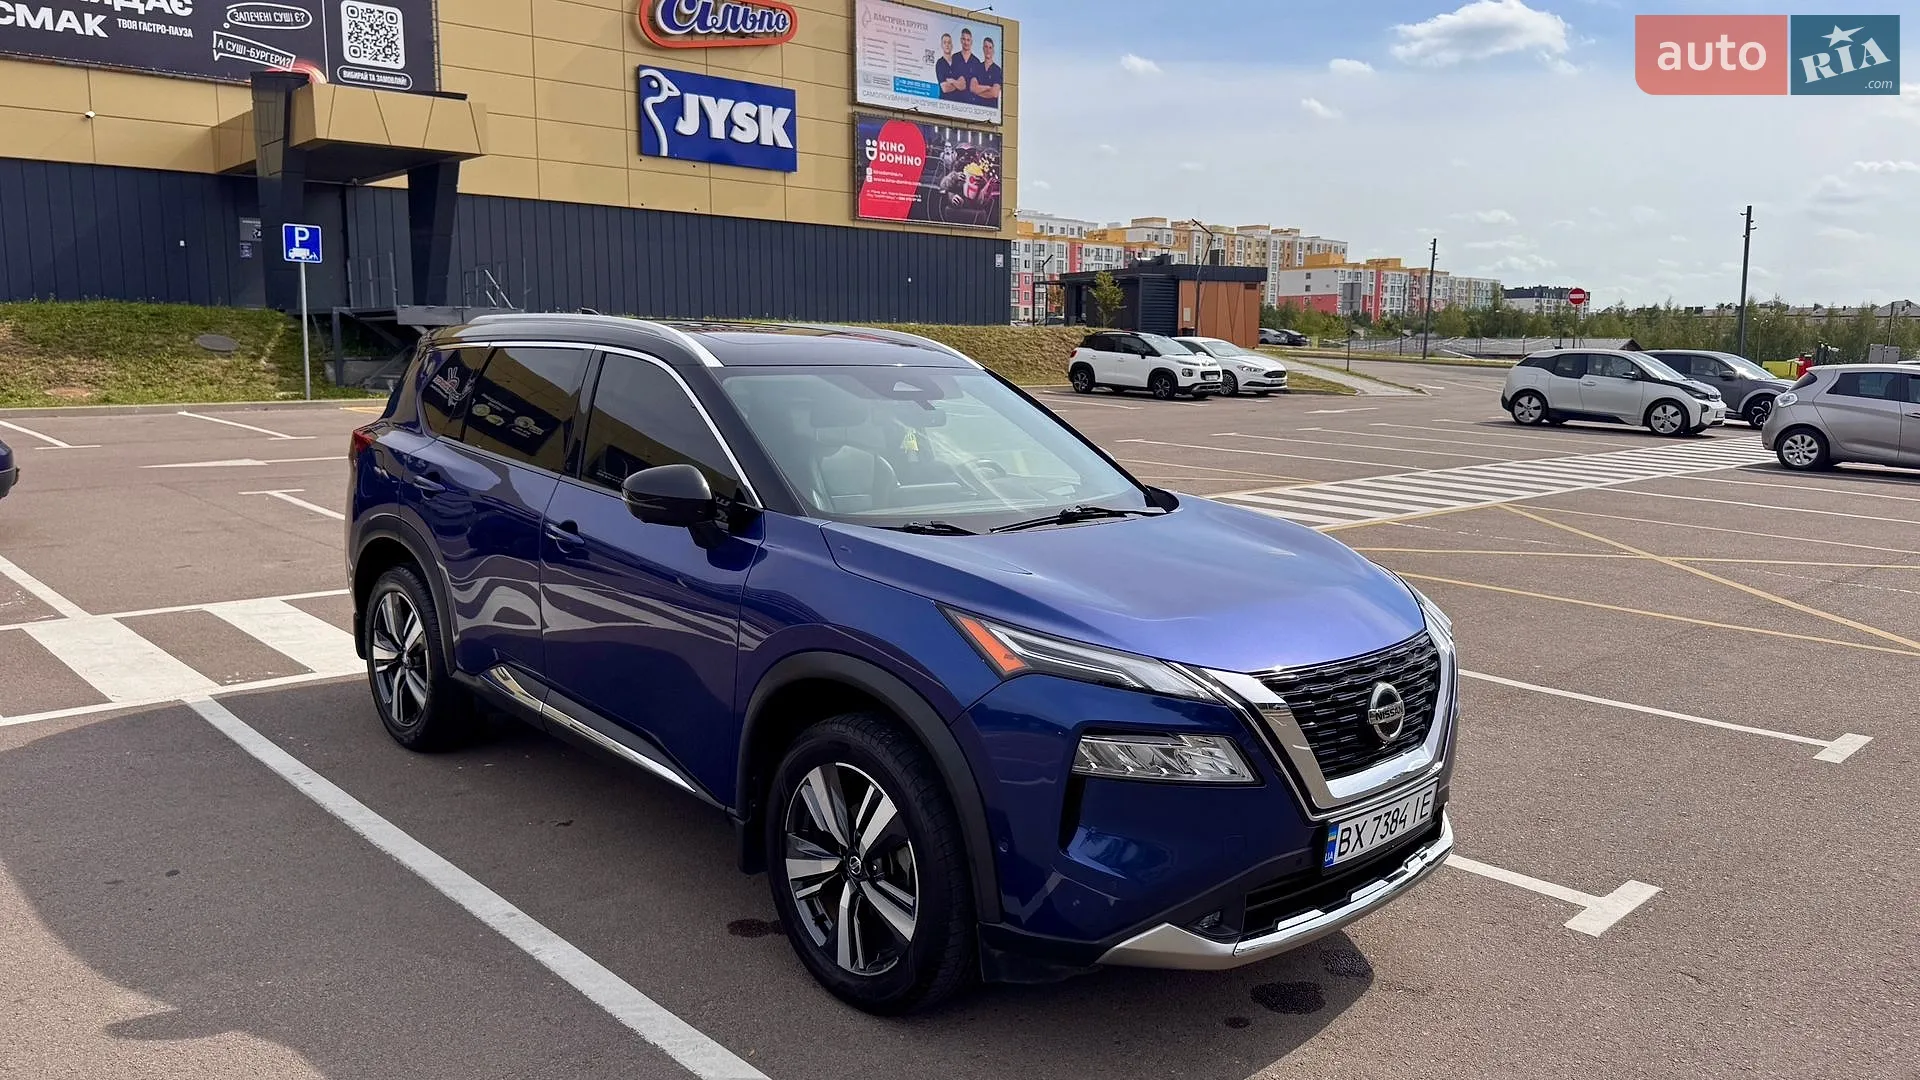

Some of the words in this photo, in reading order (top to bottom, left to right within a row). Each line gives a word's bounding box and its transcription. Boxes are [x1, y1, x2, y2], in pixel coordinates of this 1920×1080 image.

[233, 11, 272, 21] ЗАПЕЧЕНІ
[273, 12, 293, 22] СУШІ
[294, 12, 305, 22] Є?
[116, 18, 137, 30] ТВОЯ
[138, 22, 193, 38] ГАСТРО-ПАУЗА
[217, 39, 224, 49] А
[225, 41, 291, 67] СУШІ-БУРГЕРИ?
[675, 93, 793, 148] JYSK
[879, 141, 906, 153] KINO
[879, 152, 922, 167] DOMINO
[294, 226, 310, 248] P
[1375, 704, 1402, 721] NISSAN
[1338, 821, 1367, 857] BX
[1370, 801, 1410, 845] 7384
[1413, 790, 1433, 824] IE
[1325, 851, 1334, 862] UA
